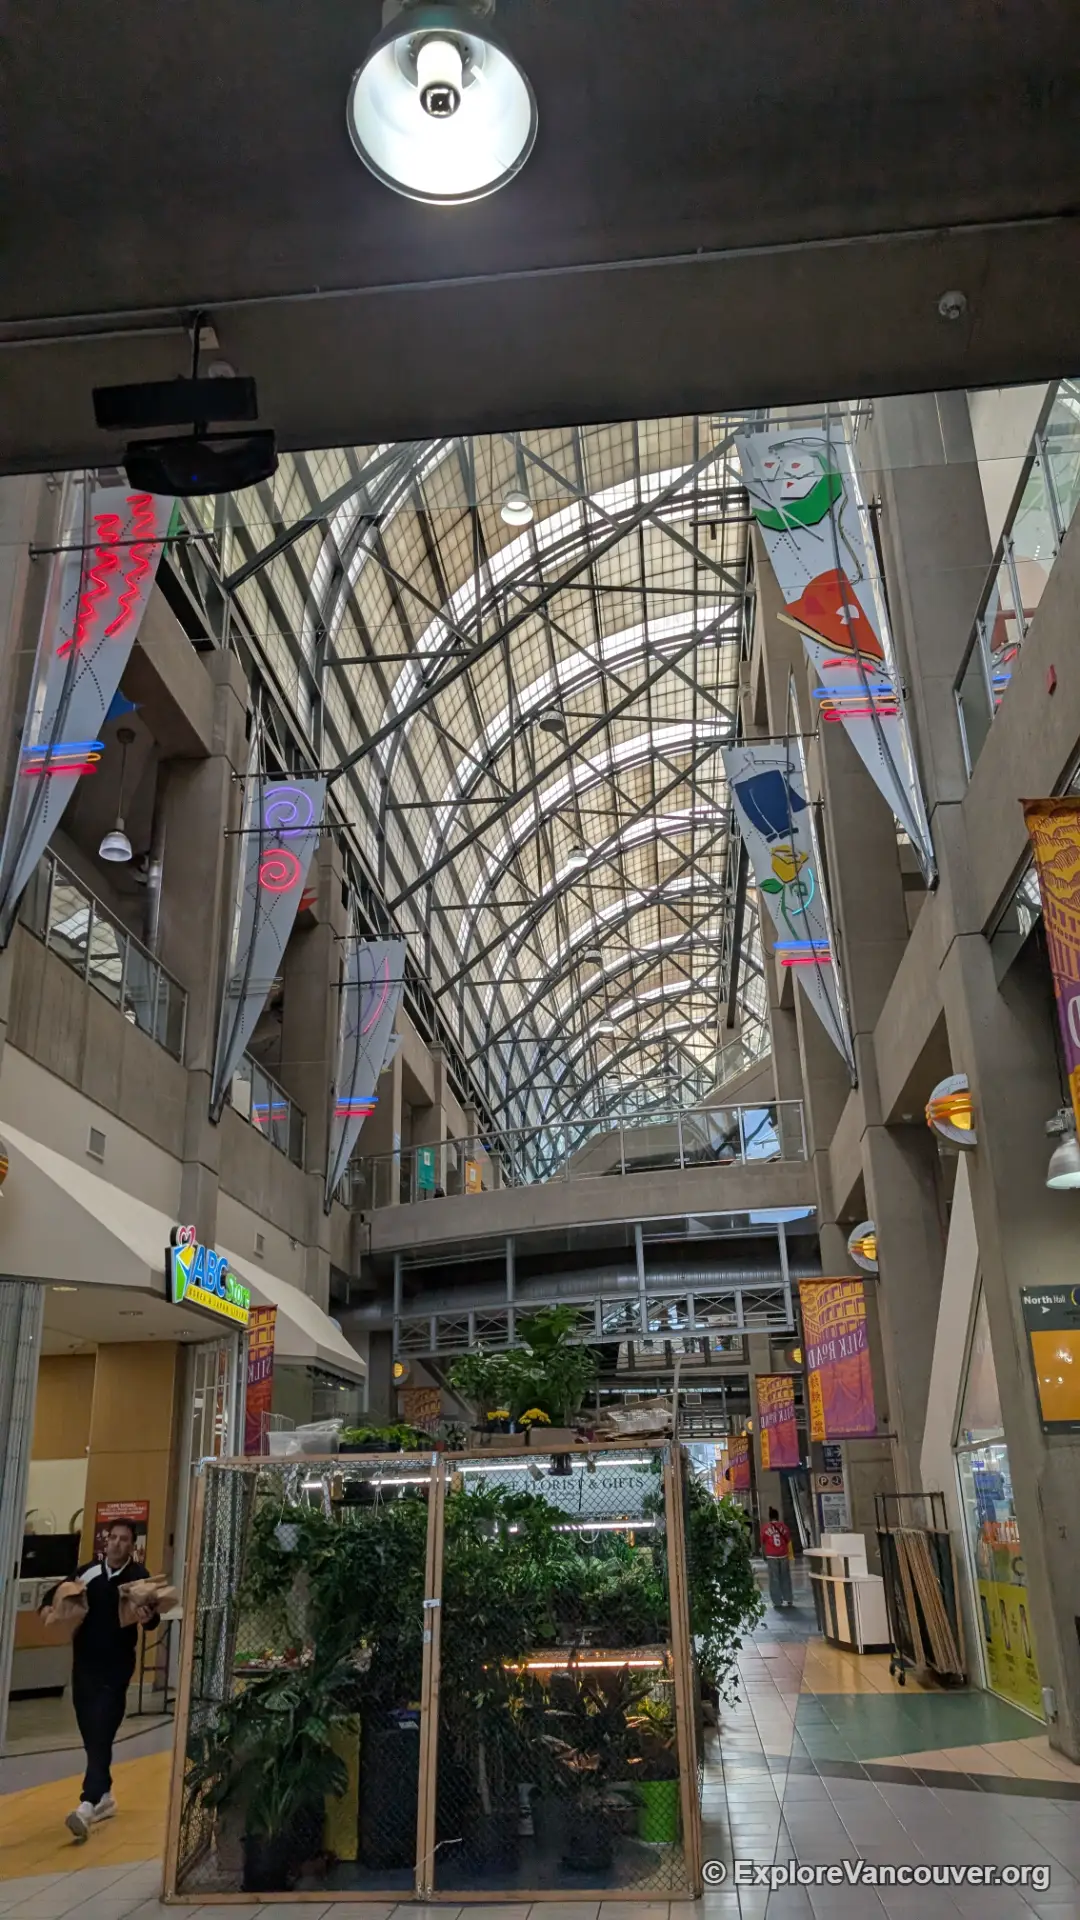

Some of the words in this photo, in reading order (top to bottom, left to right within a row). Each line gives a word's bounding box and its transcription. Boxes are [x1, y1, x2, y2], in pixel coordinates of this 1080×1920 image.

[191, 1245, 229, 1298] ABC
[1023, 1295, 1053, 1305] North
[1053, 1294, 1066, 1304] Hall
[588, 1480, 599, 1489] &
[602, 1476, 645, 1489] GIFTS
